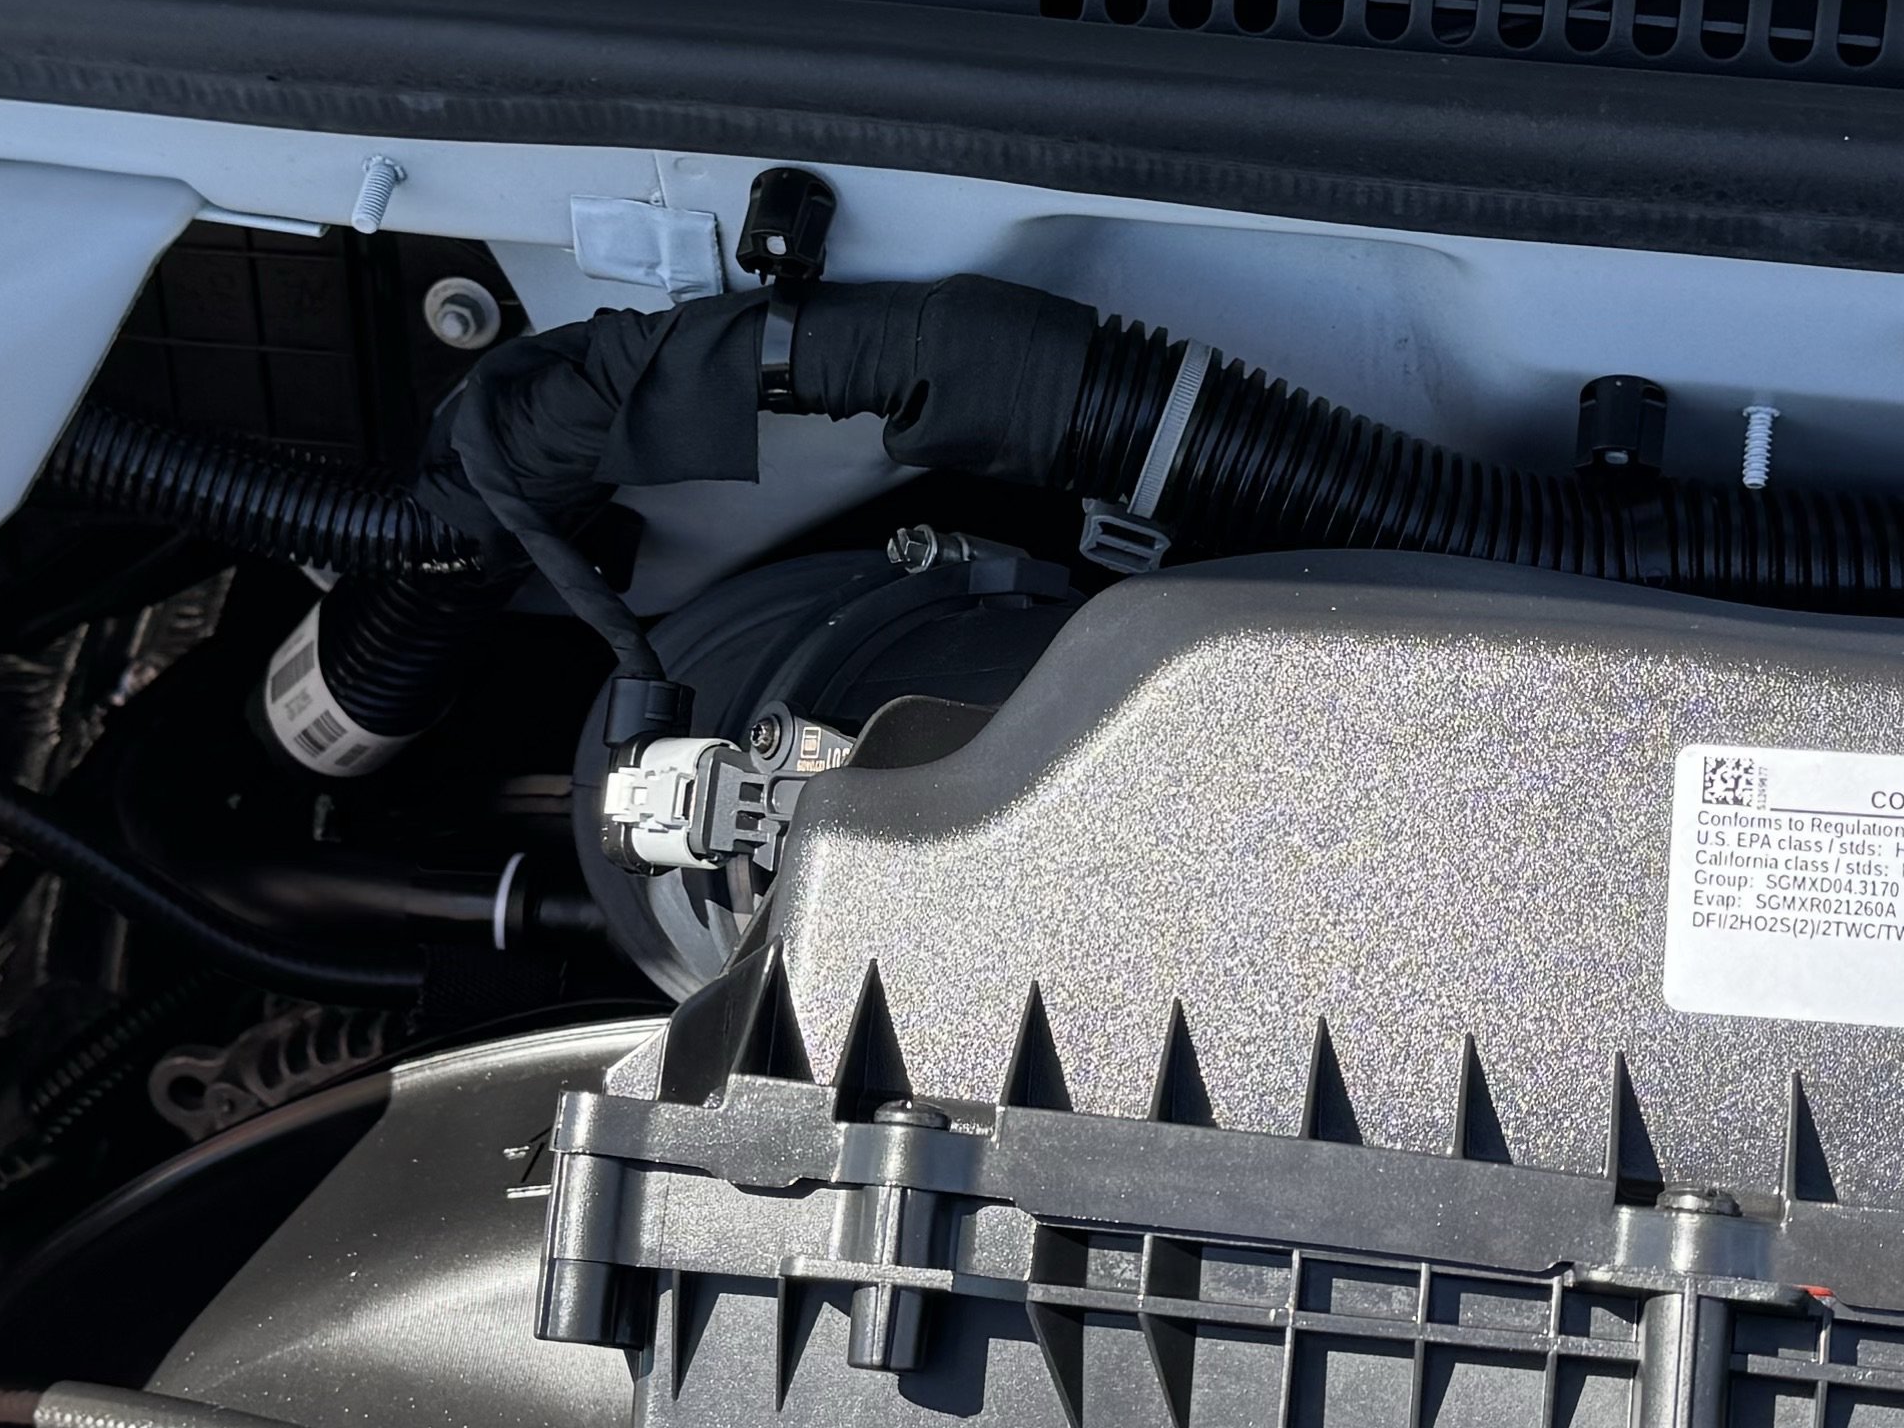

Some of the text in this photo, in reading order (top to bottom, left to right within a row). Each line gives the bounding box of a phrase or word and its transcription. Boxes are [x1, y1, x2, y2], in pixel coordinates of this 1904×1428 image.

[1697, 810, 1782, 831] Conforms
[1788, 817, 1804, 832] to
[1696, 830, 1730, 847] U.S.
[1737, 832, 1771, 850] EPA
[1778, 836, 1823, 854] class
[1839, 840, 1882, 858] stds:
[1695, 849, 1779, 870] California
[1785, 855, 1829, 874] class
[1846, 859, 1889, 878] stds:
[1694, 869, 1753, 891] Group:
[1766, 874, 1899, 899] SGMXD04.3170
[1693, 889, 1897, 918] Evap: SGMXR021260A
